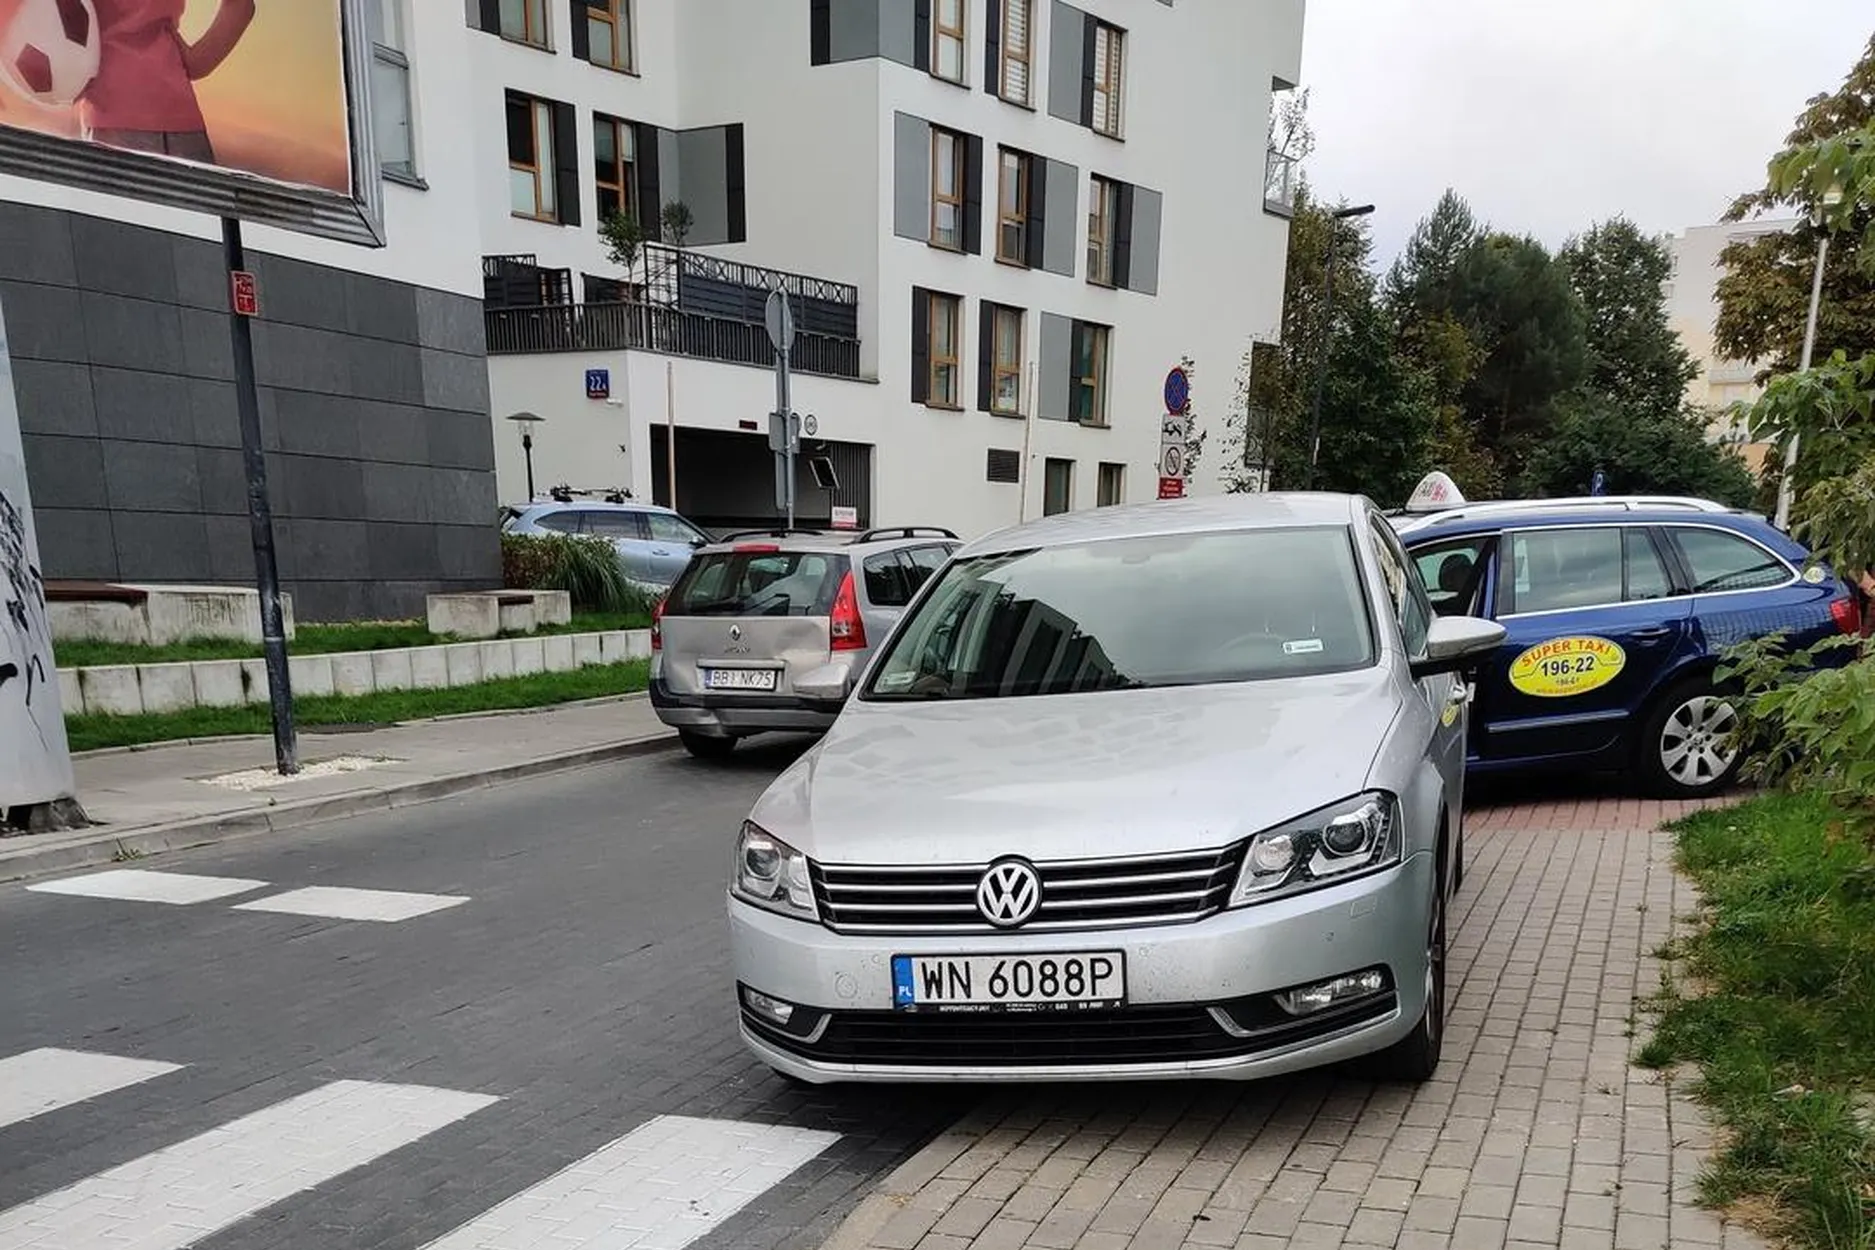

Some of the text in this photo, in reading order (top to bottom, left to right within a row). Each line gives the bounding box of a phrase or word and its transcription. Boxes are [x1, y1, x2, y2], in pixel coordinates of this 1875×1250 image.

[1521, 640, 1613, 667] SUPER TAXI
[1541, 656, 1595, 677] 196-22
[921, 958, 1113, 999] WN 6088P
[898, 985, 912, 998] PL
